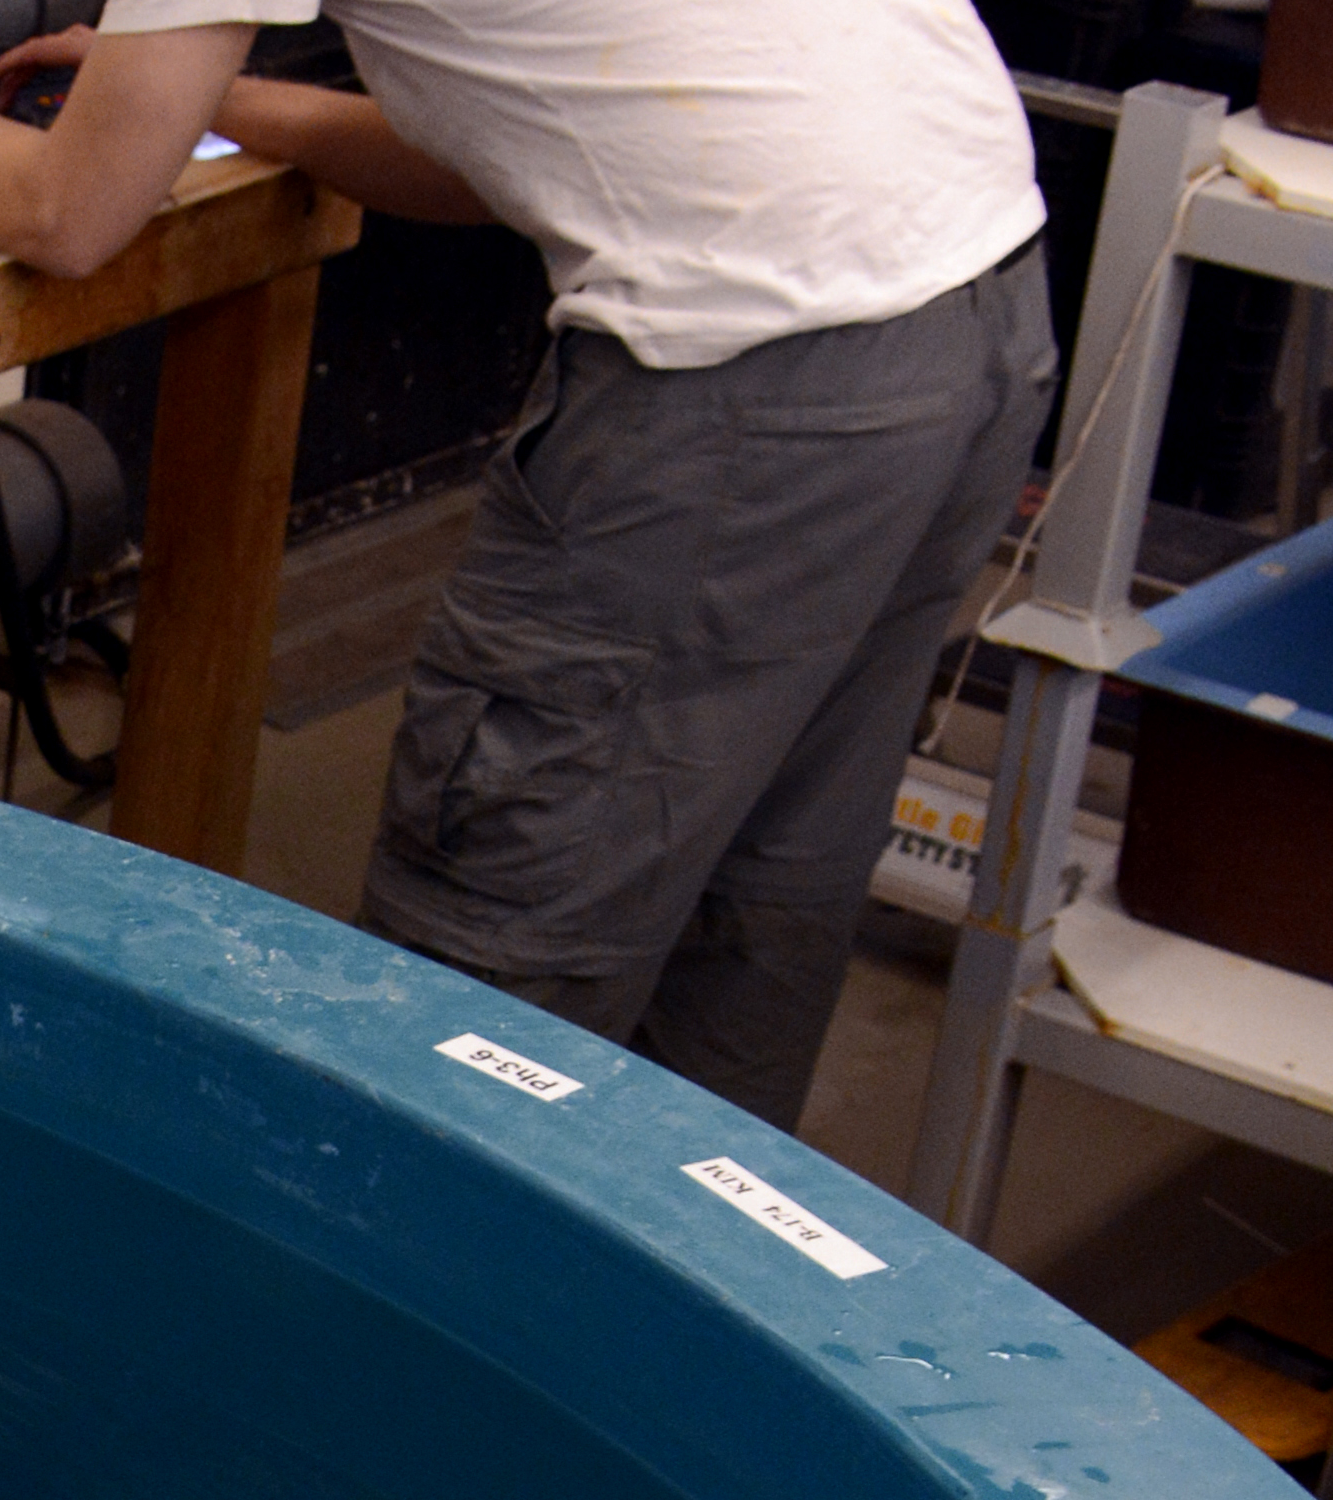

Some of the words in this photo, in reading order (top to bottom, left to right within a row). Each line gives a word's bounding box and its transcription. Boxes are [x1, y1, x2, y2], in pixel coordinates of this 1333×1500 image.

[469, 1049, 559, 1091] Ph3-6
[702, 1164, 755, 1194] KIM
[763, 1205, 823, 1241] B-174
